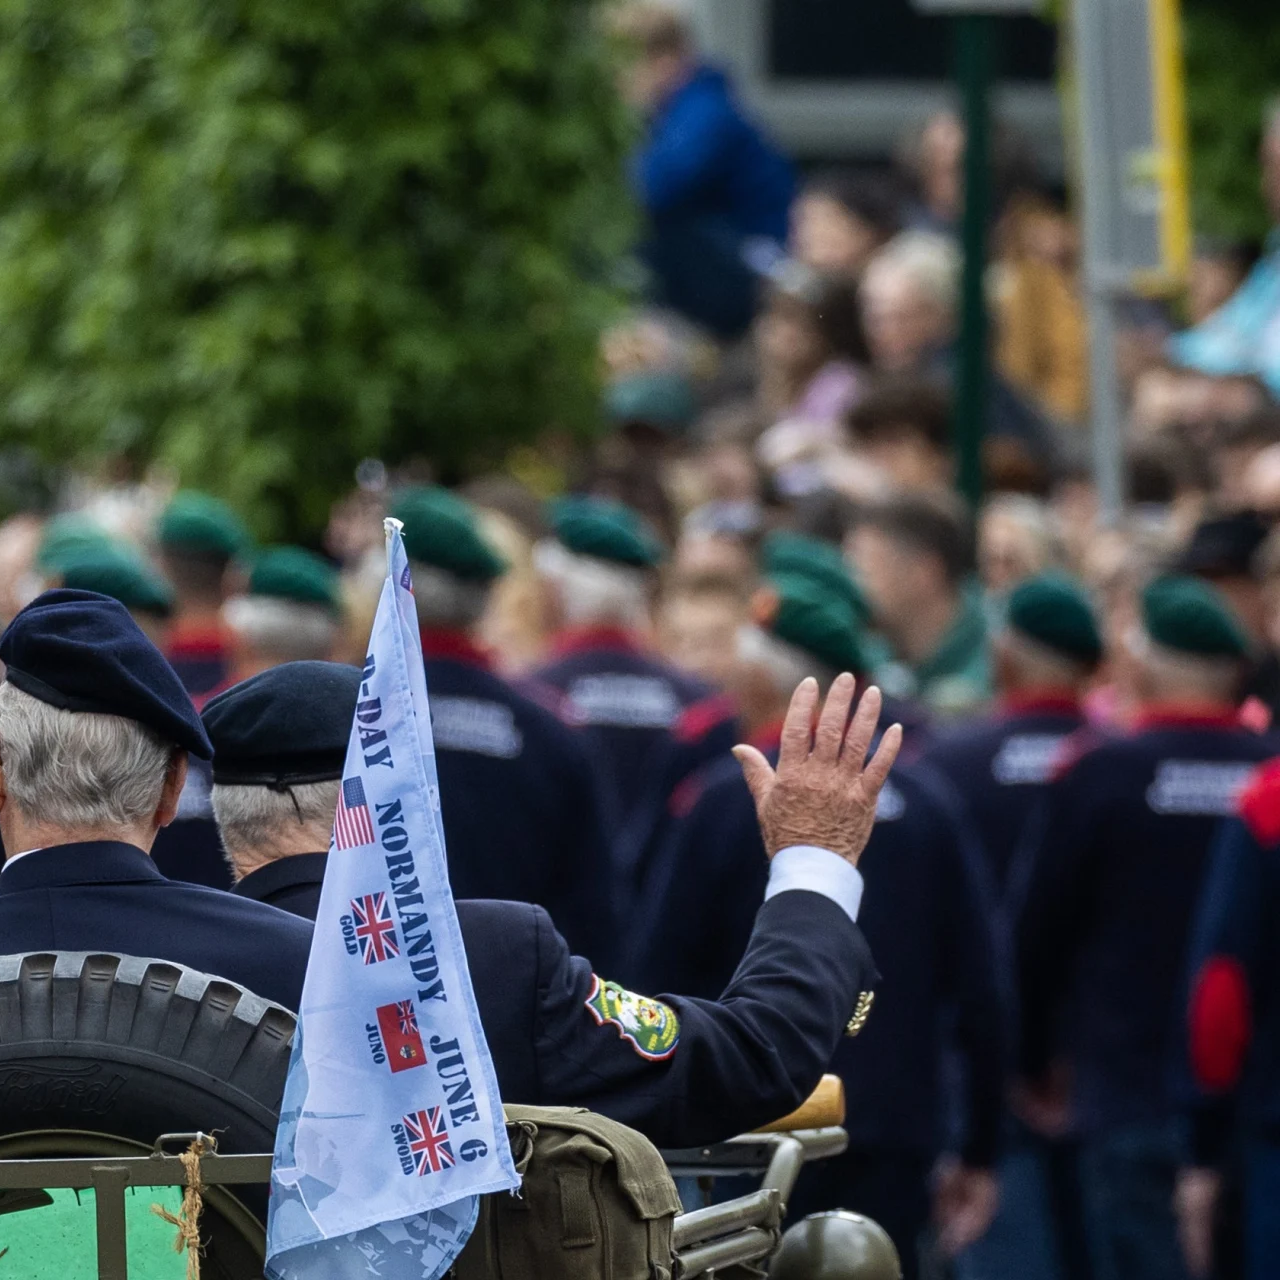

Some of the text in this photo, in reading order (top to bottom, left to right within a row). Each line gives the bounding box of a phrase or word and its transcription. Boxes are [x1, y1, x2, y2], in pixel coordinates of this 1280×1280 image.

[339, 914, 359, 956] GOLD
[375, 798, 447, 1004] NORMANDY
[429, 1034, 480, 1128] JUNE
[459, 1138, 489, 1162] 6
[365, 1022, 386, 1065] JUNO
[391, 1123, 415, 1176] SWORD
